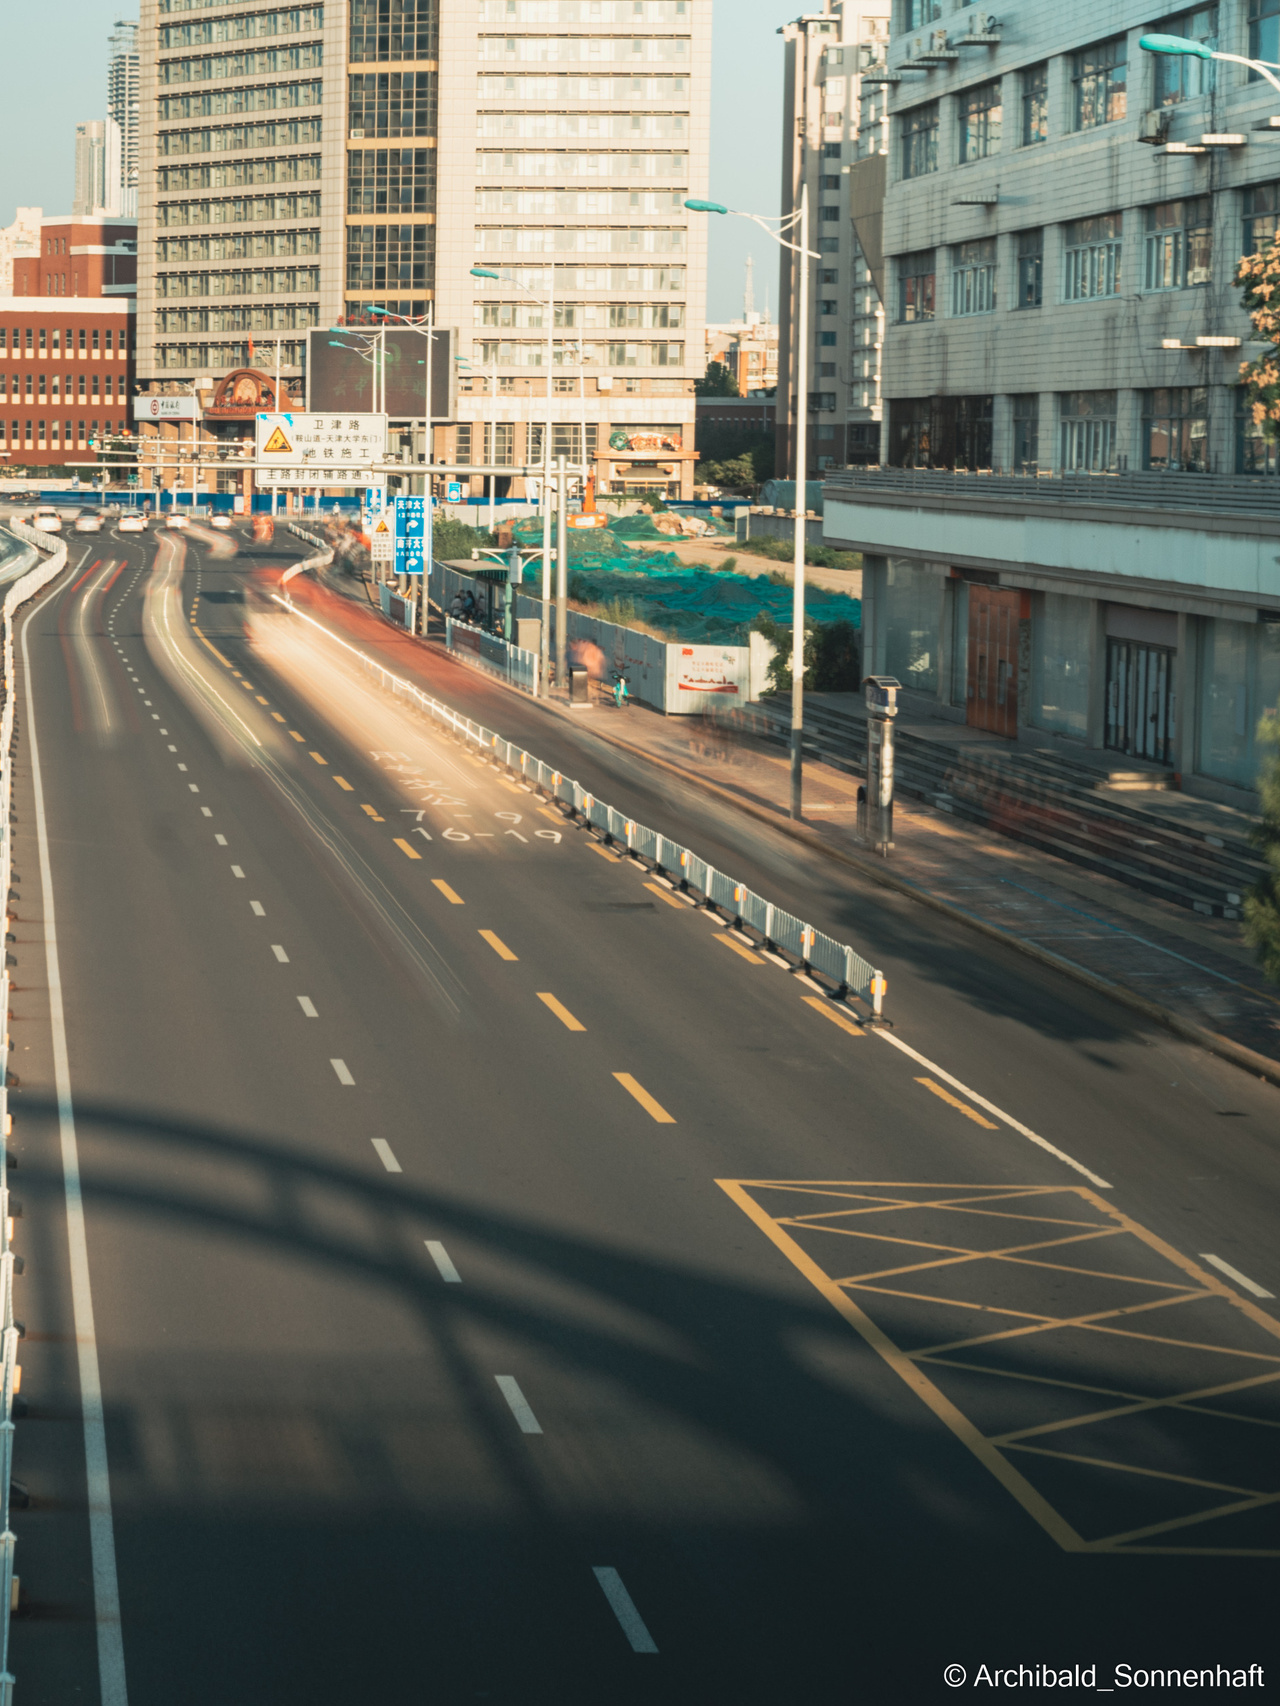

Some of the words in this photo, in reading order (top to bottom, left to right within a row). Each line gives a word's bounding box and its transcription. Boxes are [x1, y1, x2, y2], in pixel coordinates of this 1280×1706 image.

[313, 419, 360, 431] 卫津路
[411, 827, 562, 844] 16-19
